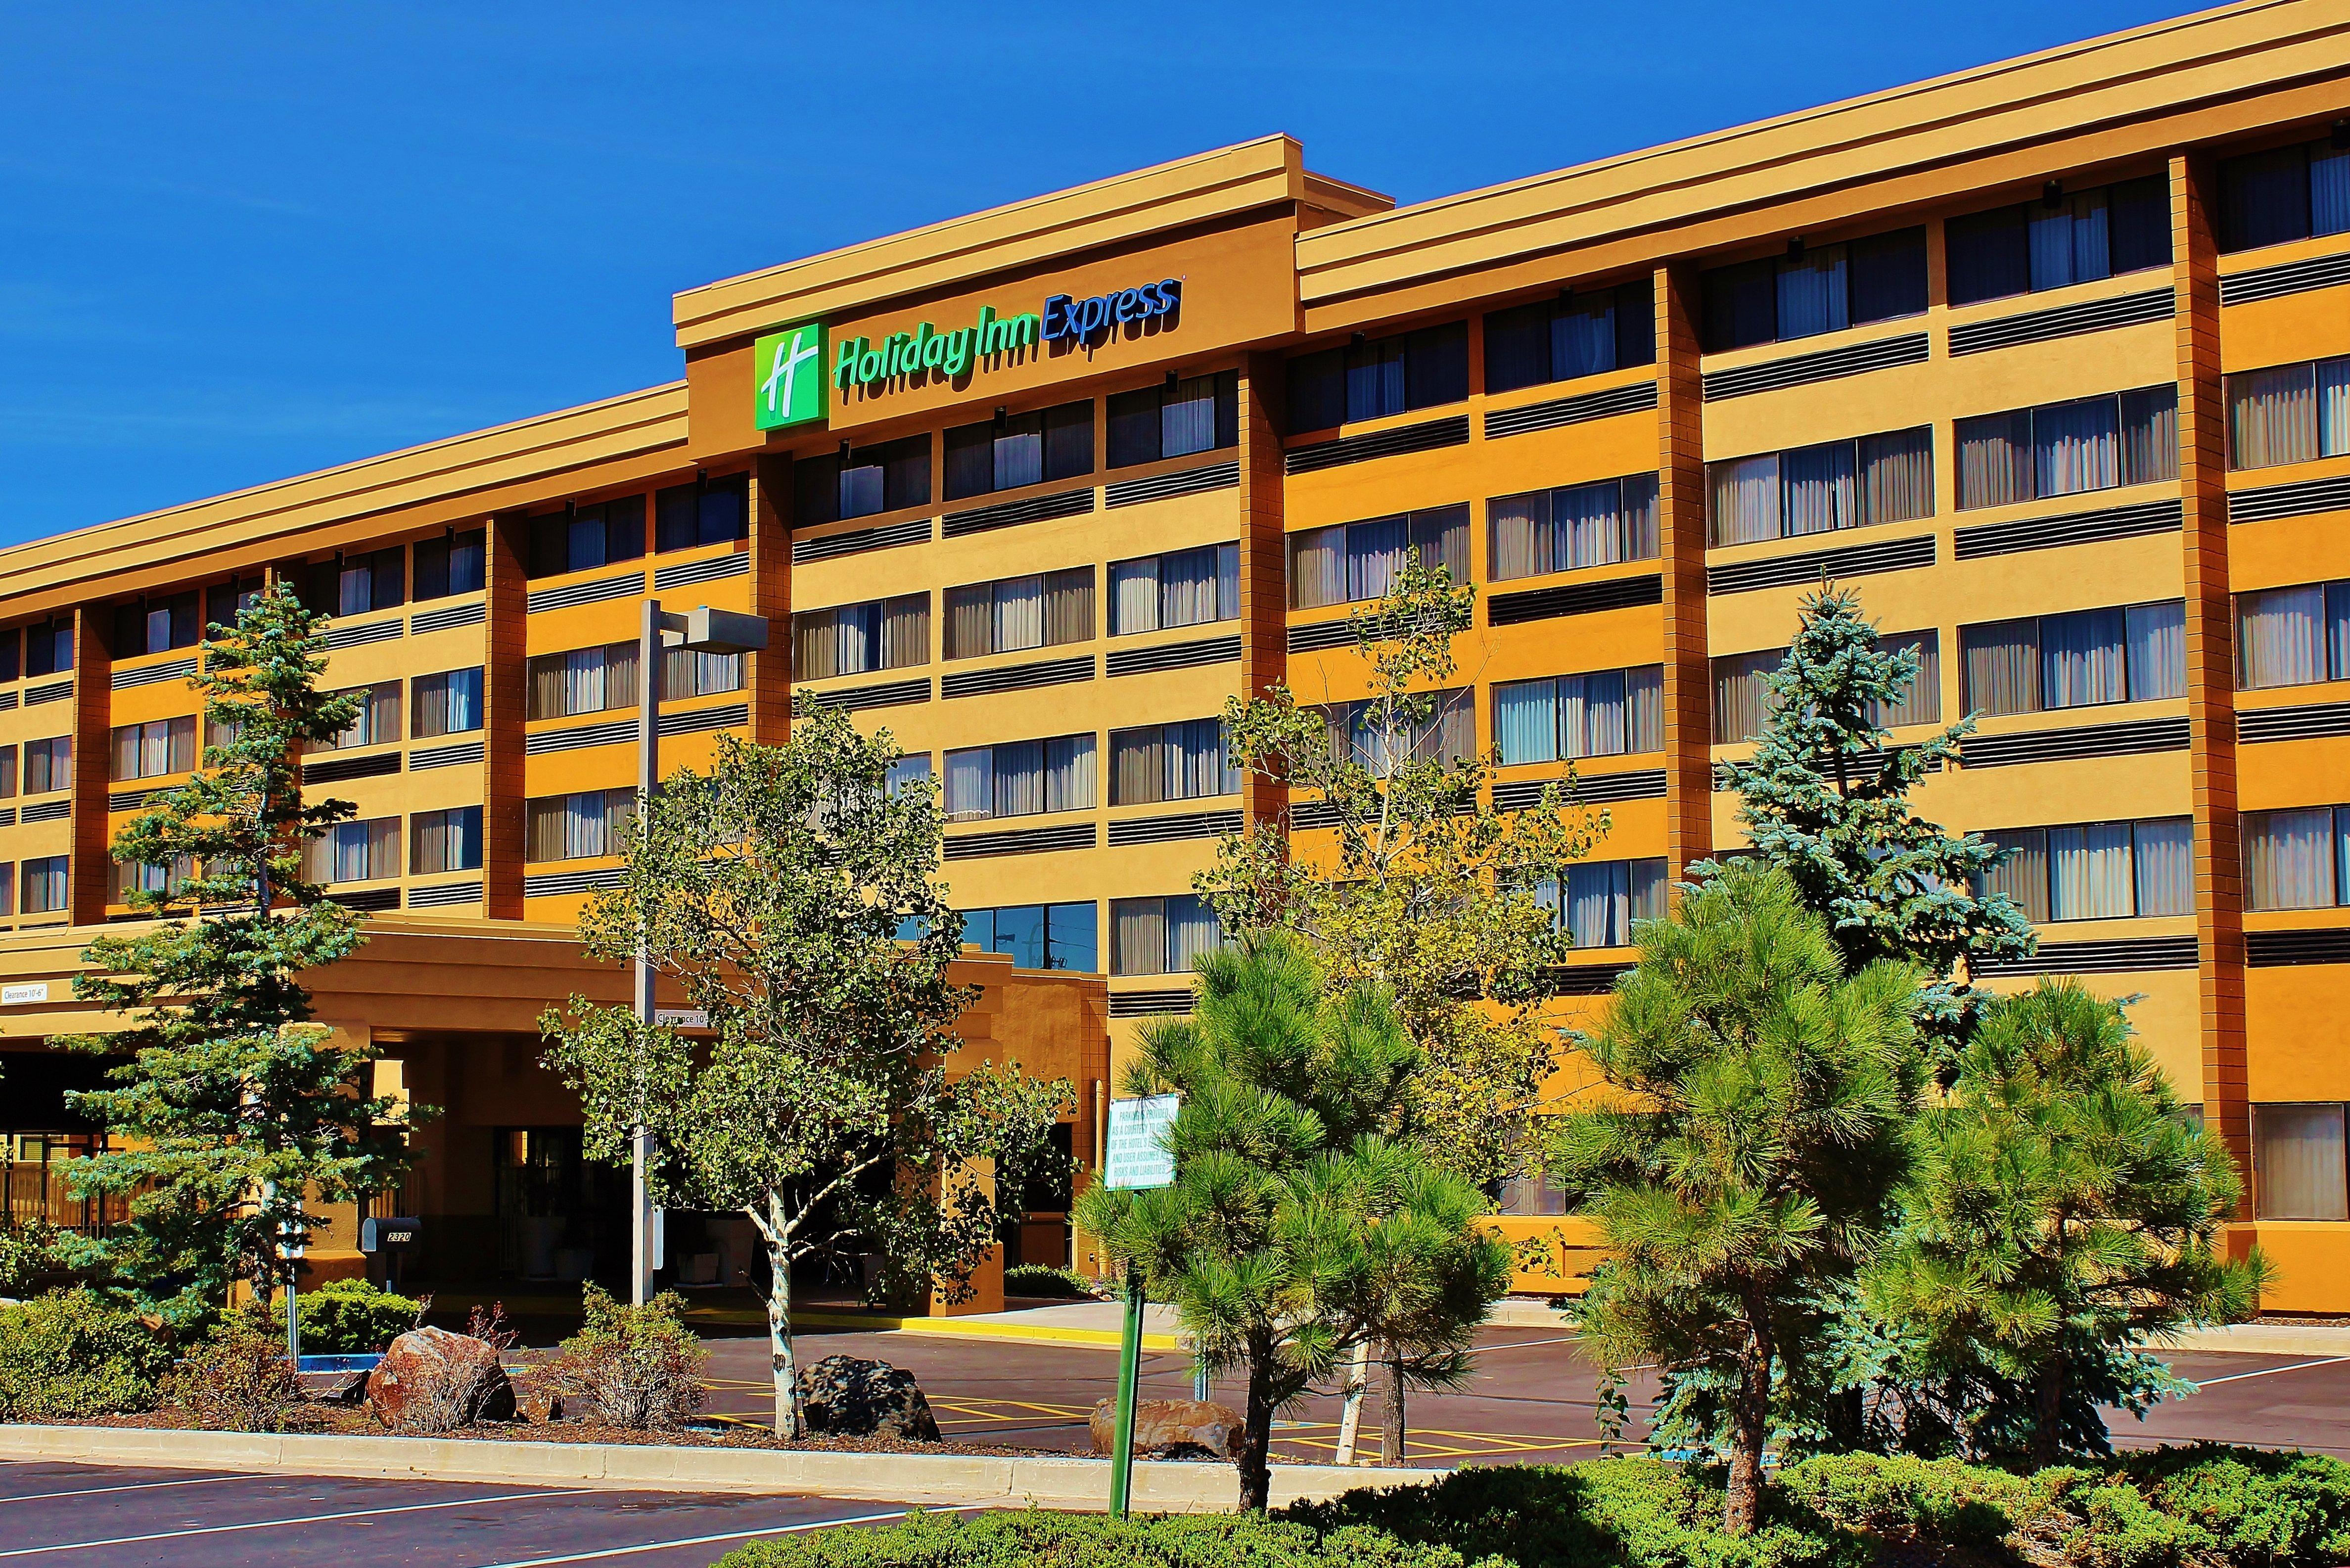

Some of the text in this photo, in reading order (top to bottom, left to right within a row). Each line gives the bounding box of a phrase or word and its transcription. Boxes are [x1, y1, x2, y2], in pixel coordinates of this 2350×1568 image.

[832, 278, 1181, 390] Holiday Inn Express
[4, 991, 28, 999] Clearance
[1146, 1108, 1168, 1119] PROVIDED
[1112, 1126, 1119, 1136] AS
[1120, 1125, 1123, 1135] A
[1124, 1123, 1148, 1134] COURTESY
[1111, 1140, 1118, 1150] OF
[1119, 1139, 1128, 1149] THE
[1128, 1137, 1147, 1148] HOTEL'S
[1112, 1153, 1122, 1163] AND
[1123, 1152, 1136, 1162] USER
[1137, 1151, 1159, 1162] ASSUMES
[1114, 1164, 1166, 1177] RISKS AND LIABILITIES
